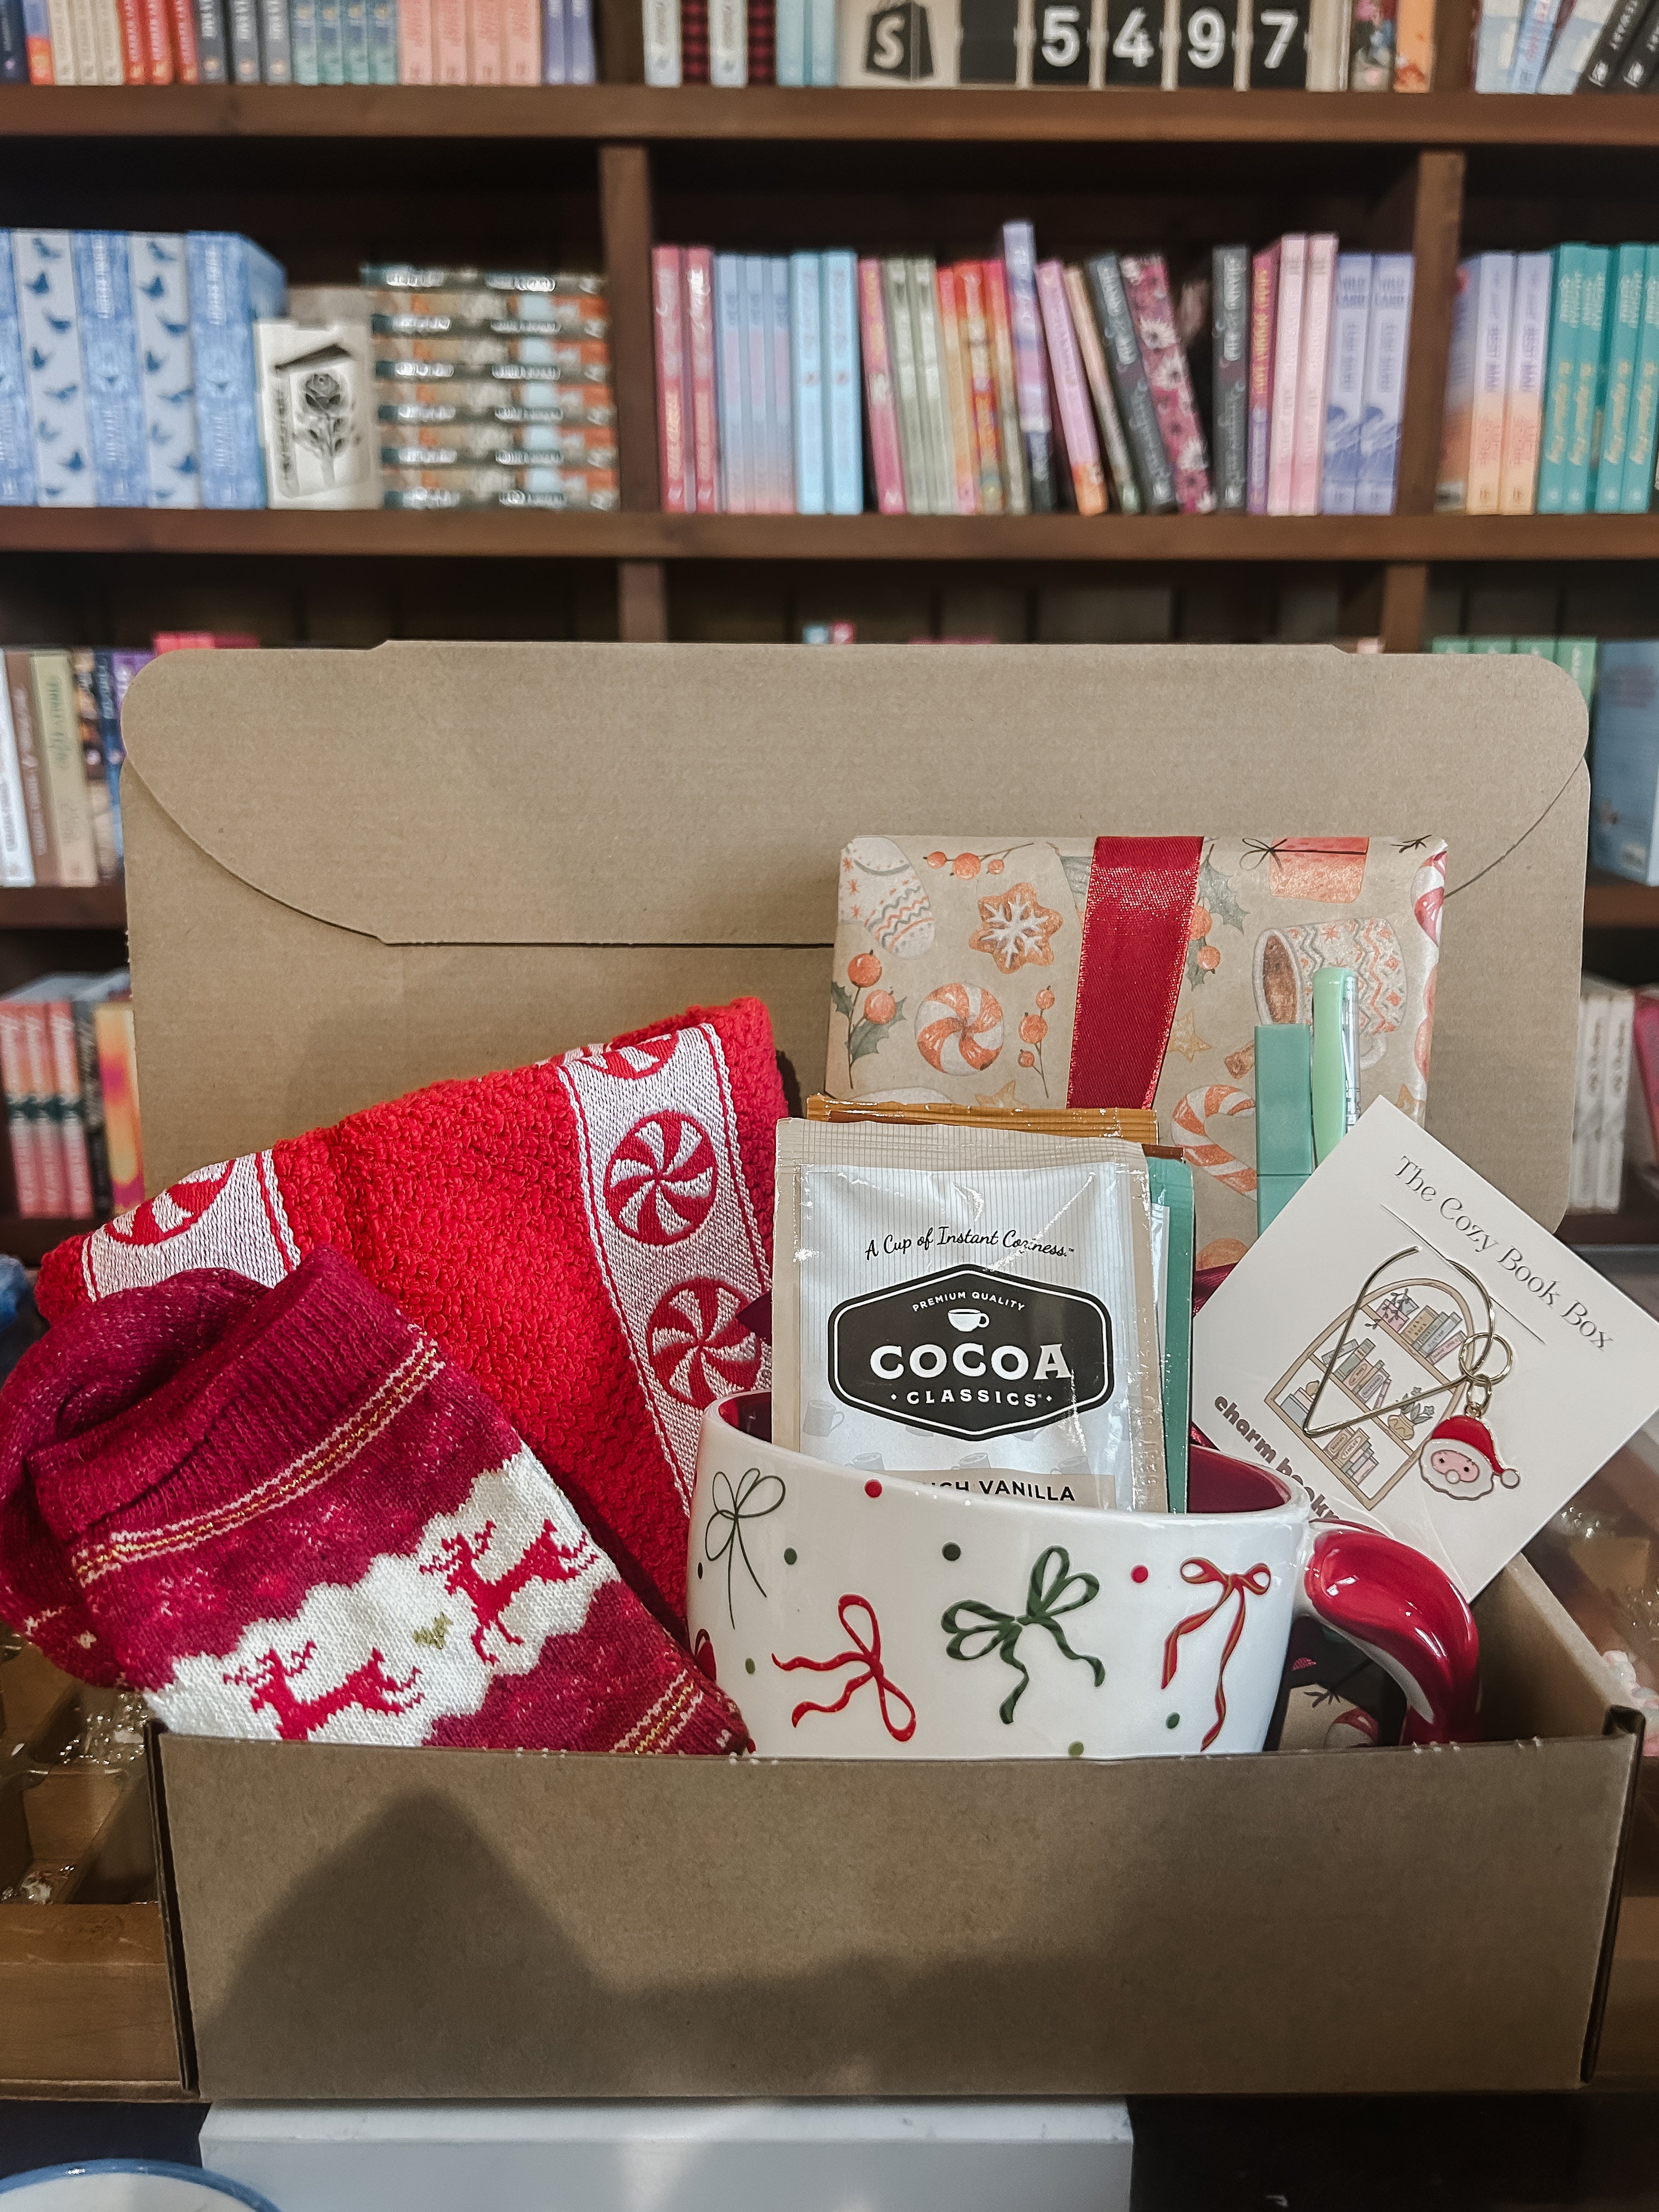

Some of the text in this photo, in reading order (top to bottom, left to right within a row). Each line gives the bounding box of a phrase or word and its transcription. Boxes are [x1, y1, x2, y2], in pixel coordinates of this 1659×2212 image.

[865, 1239, 879, 1261] A
[884, 1235, 911, 1254] Cup
[917, 1227, 934, 1251] of
[937, 1226, 999, 1246] Instant
[1394, 1155, 1613, 1351] The Cozy Book Box
[912, 1291, 1025, 1312] PREMIUM QUALITY
[870, 1342, 1072, 1380] COCOA
[1214, 1395, 1277, 1464] charm
[979, 1480, 1076, 1501] VANILLA
